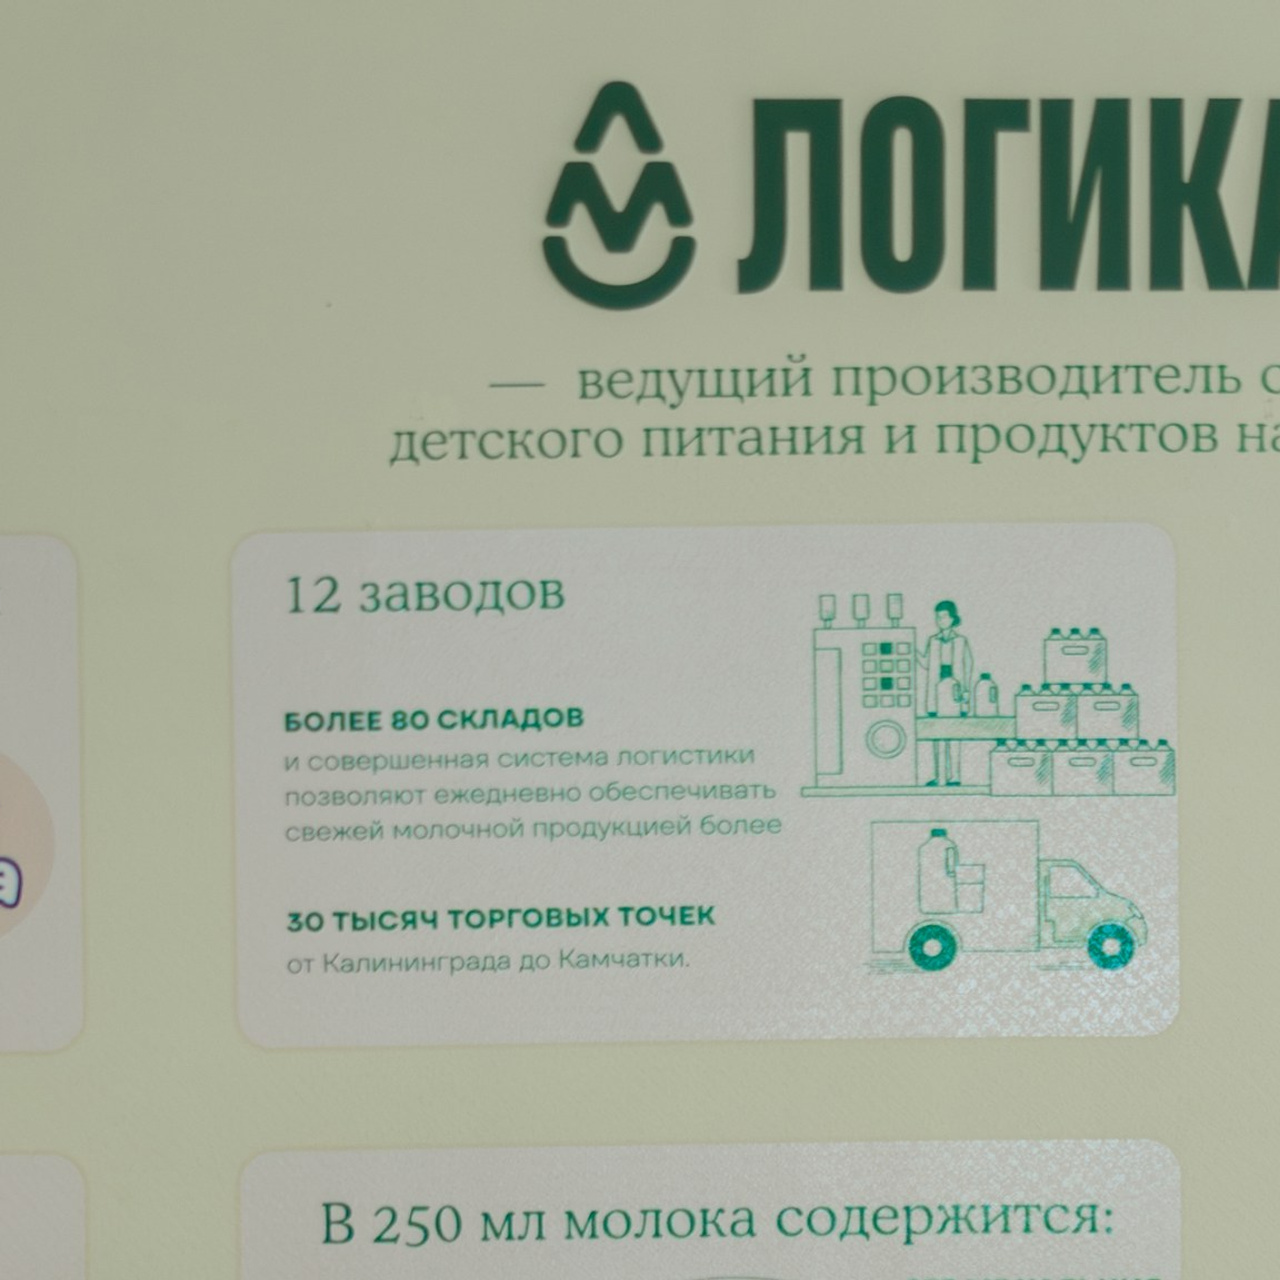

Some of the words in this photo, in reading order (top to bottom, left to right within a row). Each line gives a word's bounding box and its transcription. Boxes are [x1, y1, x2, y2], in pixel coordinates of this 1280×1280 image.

[577, 352, 813, 411] ведущий
[831, 362, 1243, 408] производитель
[388, 426, 625, 467] детского
[642, 423, 866, 459] питания
[883, 423, 918, 456] и
[935, 421, 1220, 466] продуктов
[287, 574, 342, 615] 12
[358, 577, 567, 617] заводов
[282, 708, 383, 734] БОЛЕЕ
[389, 707, 431, 733] 80
[434, 705, 586, 734] СКЛАДОВ
[284, 756, 300, 772] и
[307, 752, 489, 775] совершенная
[497, 750, 609, 768] система
[616, 748, 756, 766] логистики
[285, 788, 425, 807] позволяют
[433, 786, 582, 806] ежедневно
[588, 780, 777, 802] обеспечивать
[284, 820, 384, 842] свежей
[391, 817, 525, 840] молочной
[532, 815, 692, 843] продукцией
[698, 814, 783, 836] более
[285, 909, 326, 934] 30
[330, 908, 440, 933] ТЫСЯЧ
[446, 905, 611, 932] ТОРГОВЫХ
[615, 903, 717, 928] ТОЧЕК
[286, 957, 314, 975] от
[323, 952, 511, 976] Калининграда
[518, 953, 551, 973] до
[558, 948, 690, 970] Камчатки.
[321, 1200, 356, 1246] В
[372, 1203, 464, 1249] 250
[479, 1209, 547, 1243] мл
[563, 1206, 758, 1242] молока
[774, 1202, 1114, 1247] содержится:
